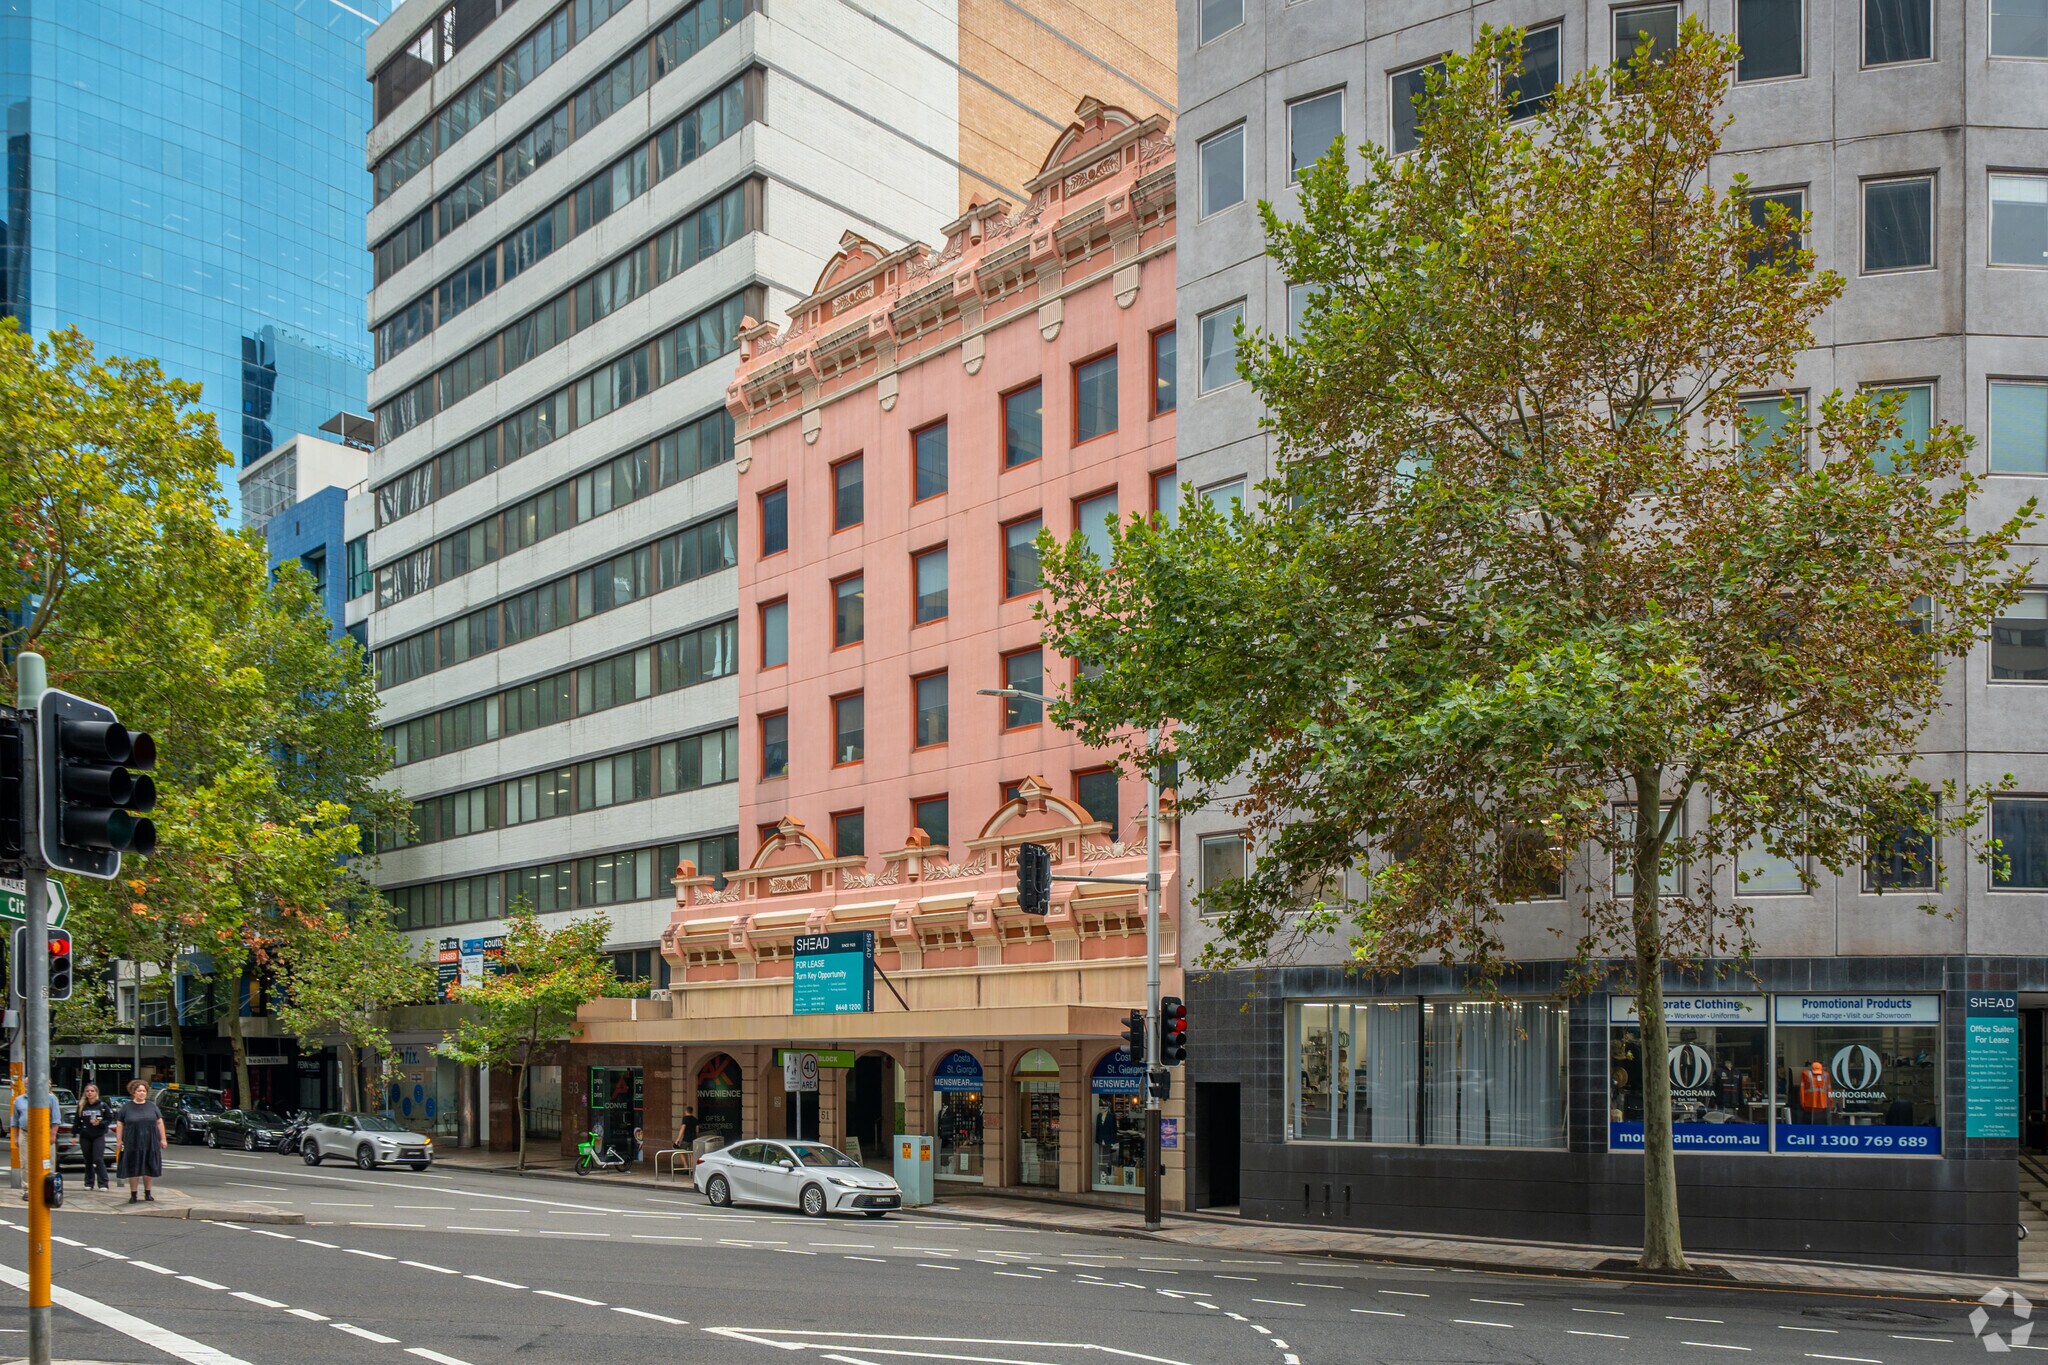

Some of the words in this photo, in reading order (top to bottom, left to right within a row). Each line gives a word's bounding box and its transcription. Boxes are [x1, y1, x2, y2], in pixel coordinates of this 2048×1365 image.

[1, 880, 25, 891] WALKE
[8, 897, 25, 914] Cit
[440, 941, 457, 950] cotts
[796, 937, 829, 951] SHEAD
[440, 953, 457, 961] LEASED
[796, 961, 807, 969] FOR
[808, 960, 825, 968] LEASE
[796, 972, 807, 980] Turn
[808, 971, 817, 980] Key
[818, 970, 846, 980] Opportunity
[835, 1003, 848, 1011] 8448
[1694, 999, 1741, 1011] Clothing
[1802, 998, 1863, 1009] Promotional
[1866, 998, 1912, 1009] Products
[1970, 997, 2015, 1008] SHEAD
[1970, 1025, 1991, 1033] Office
[1993, 1025, 2015, 1033] Suites
[1975, 1035, 1987, 1043] For
[953, 1053, 970, 1063] Costa
[804, 1060, 816, 1073] 40
[956, 1065, 978, 1075] Giorgio
[1107, 1064, 1116, 1074] St.
[569, 1082, 579, 1094] 53
[802, 1081, 817, 1089] AREA
[1092, 1080, 1136, 1088] MENSWEAR
[821, 1111, 829, 1120] 51
[1787, 1134, 1814, 1145] Call
[1820, 1136, 1859, 1146] 1300
[1864, 1136, 1893, 1147] 769
[1898, 1137, 1928, 1147] 689
